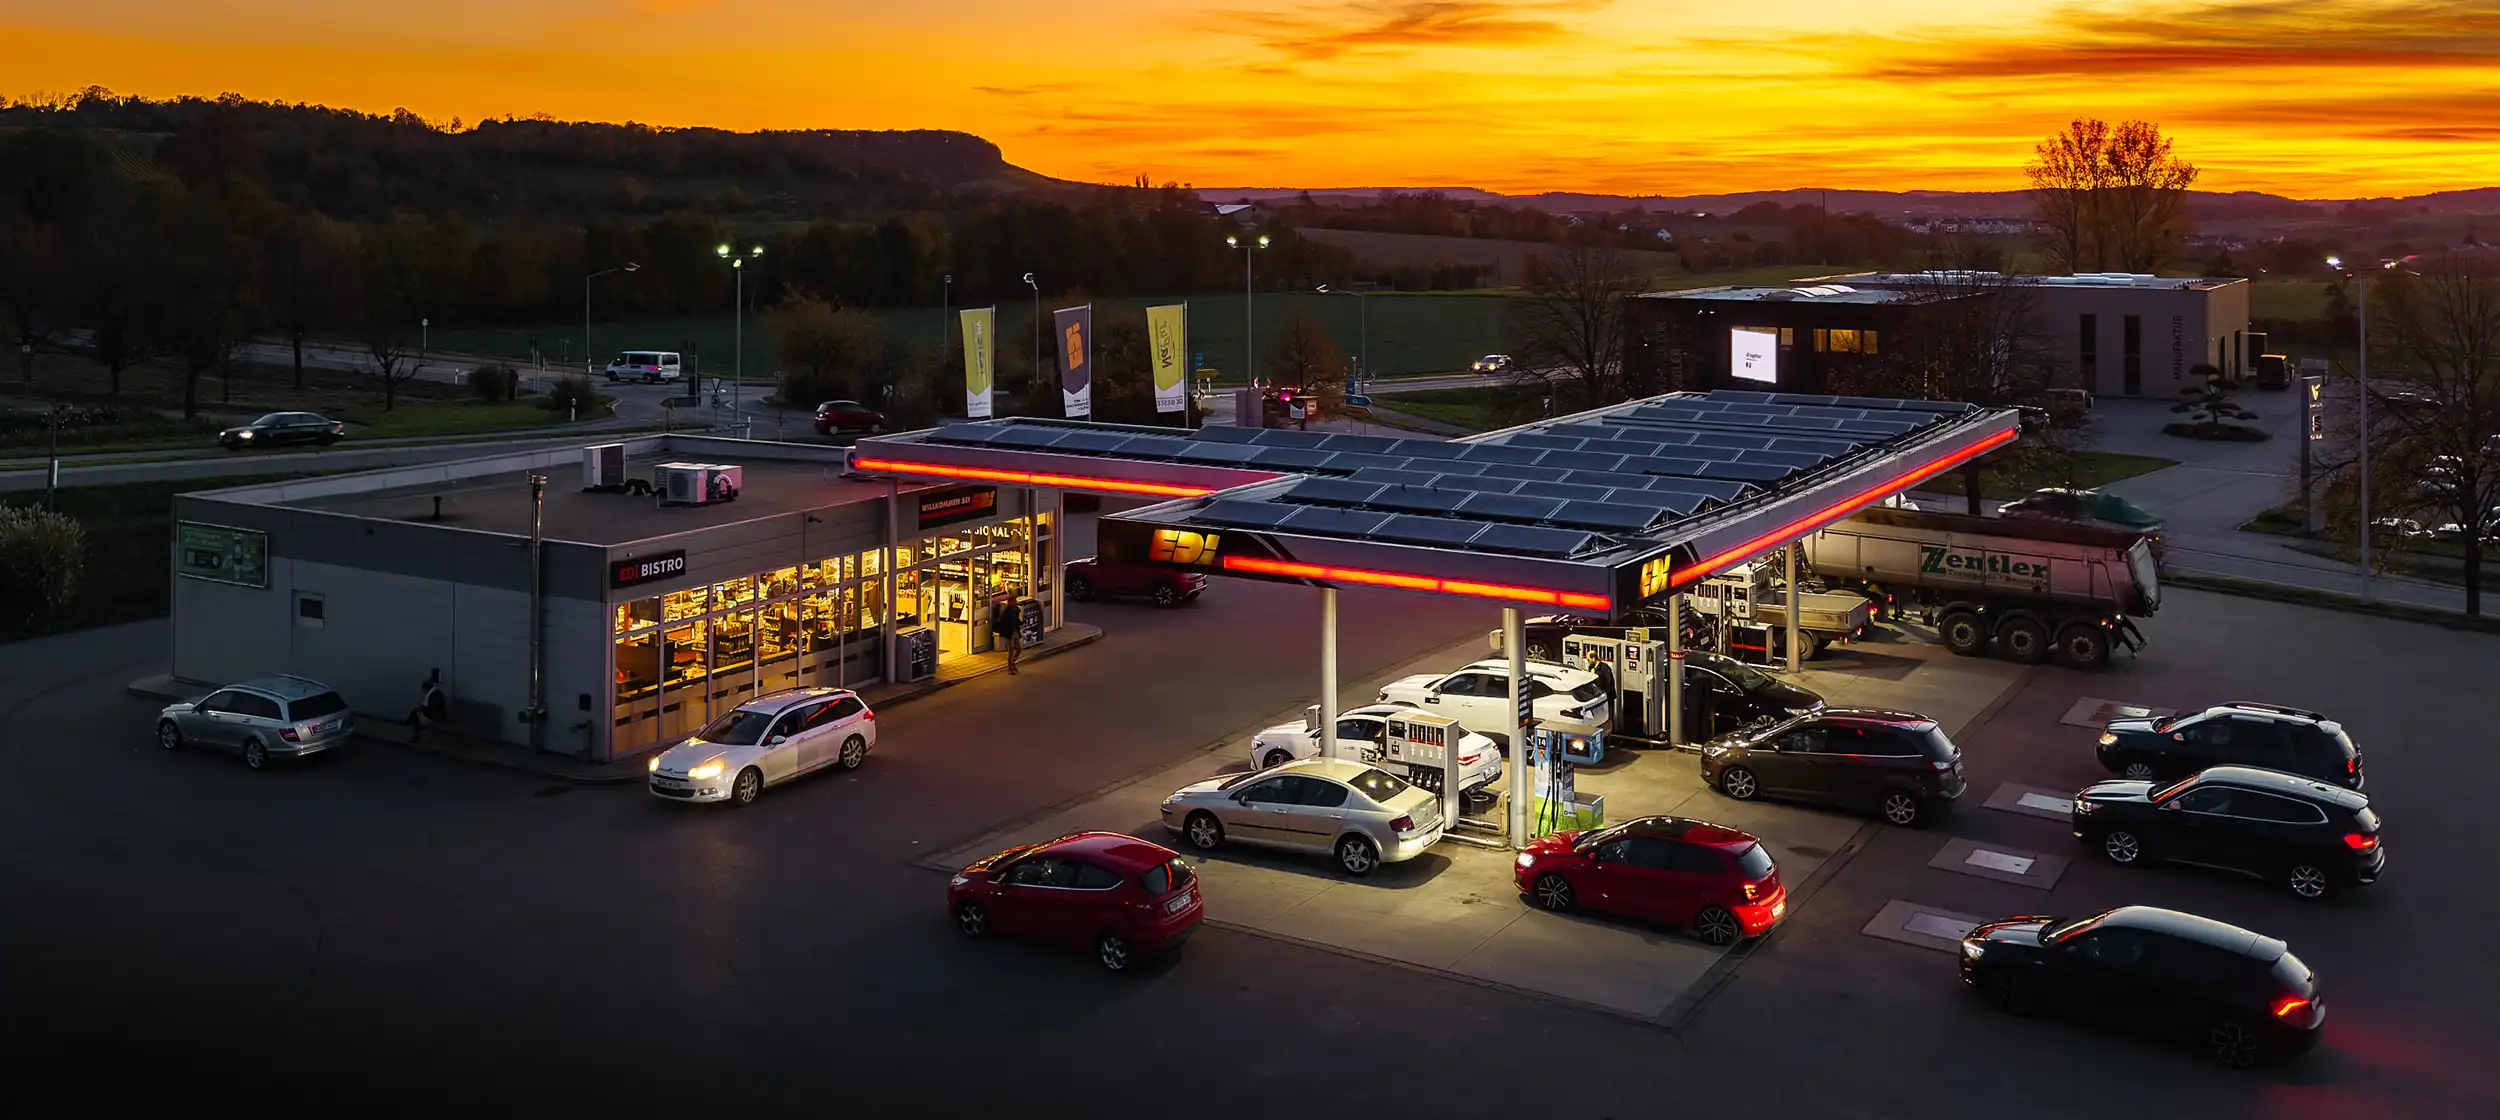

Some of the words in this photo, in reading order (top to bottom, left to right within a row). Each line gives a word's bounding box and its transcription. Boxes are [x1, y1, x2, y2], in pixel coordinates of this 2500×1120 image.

[2172, 315, 2183, 380] MANUFAKTUR
[921, 498, 961, 512] WILLKOMMEN
[641, 557, 684, 577] BISTRO
[1921, 545, 2048, 578] Zentler
[1537, 738, 1546, 746] 14
